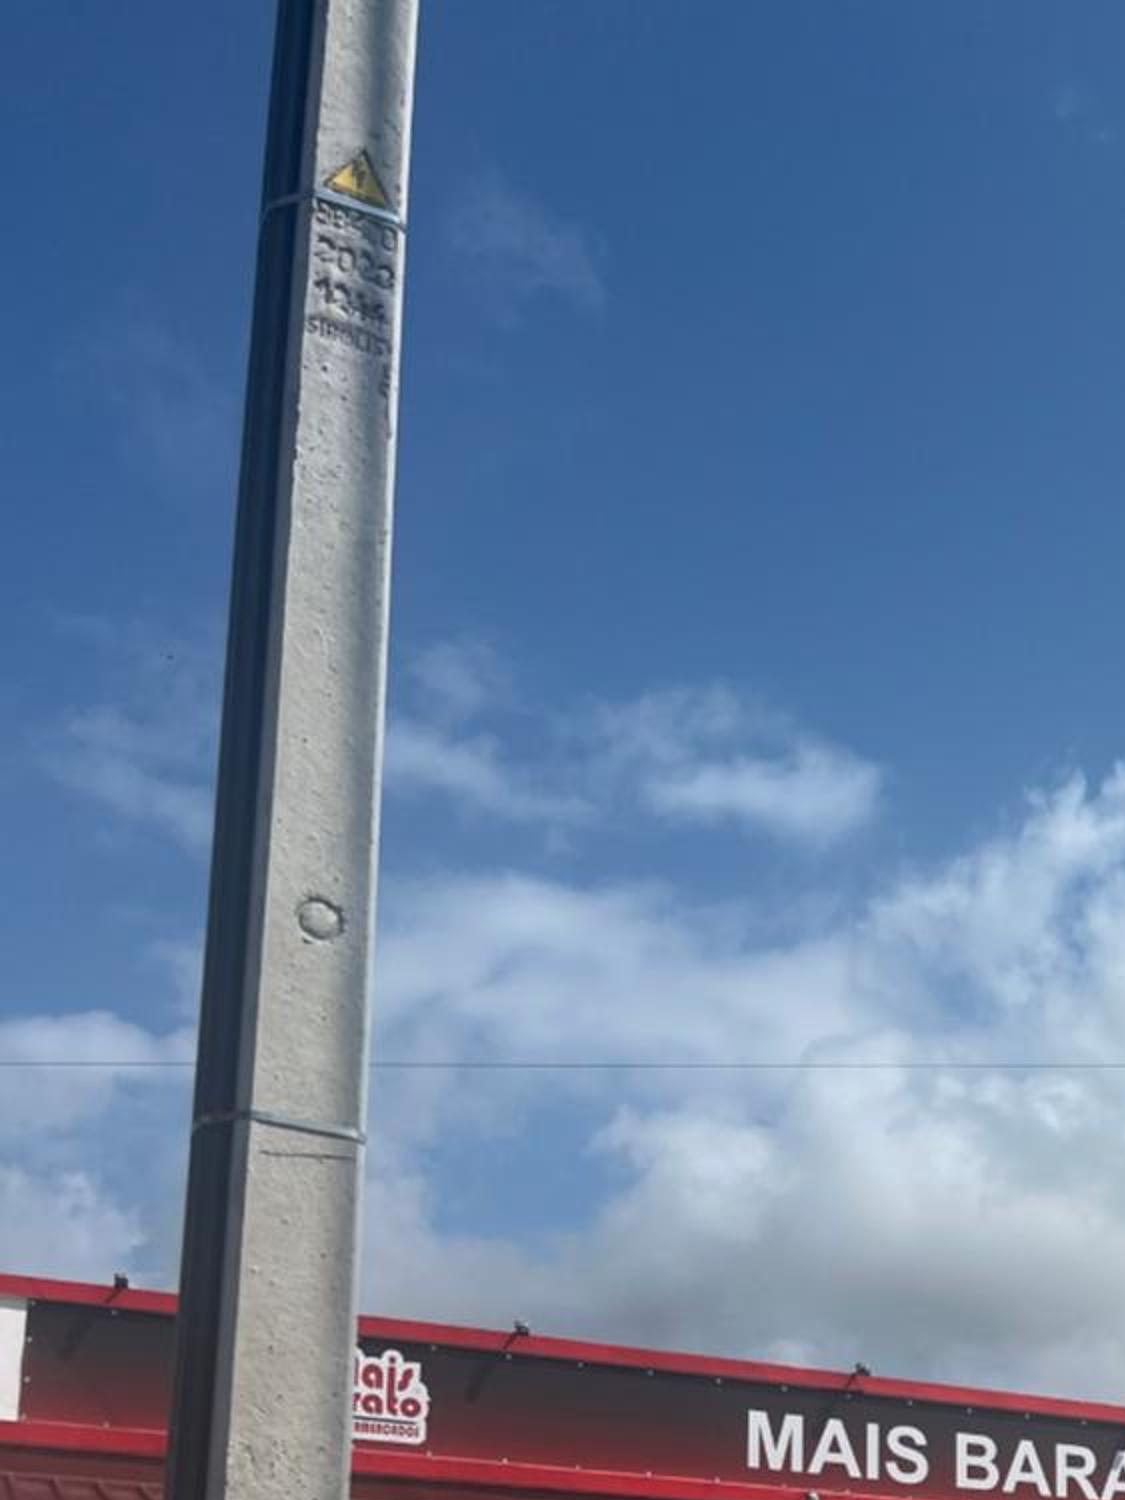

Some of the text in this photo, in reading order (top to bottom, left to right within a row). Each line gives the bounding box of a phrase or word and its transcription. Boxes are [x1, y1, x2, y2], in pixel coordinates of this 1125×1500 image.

[354, 1356, 414, 1391] ais
[353, 1393, 421, 1418] rato
[746, 1409, 929, 1485] MAIS
